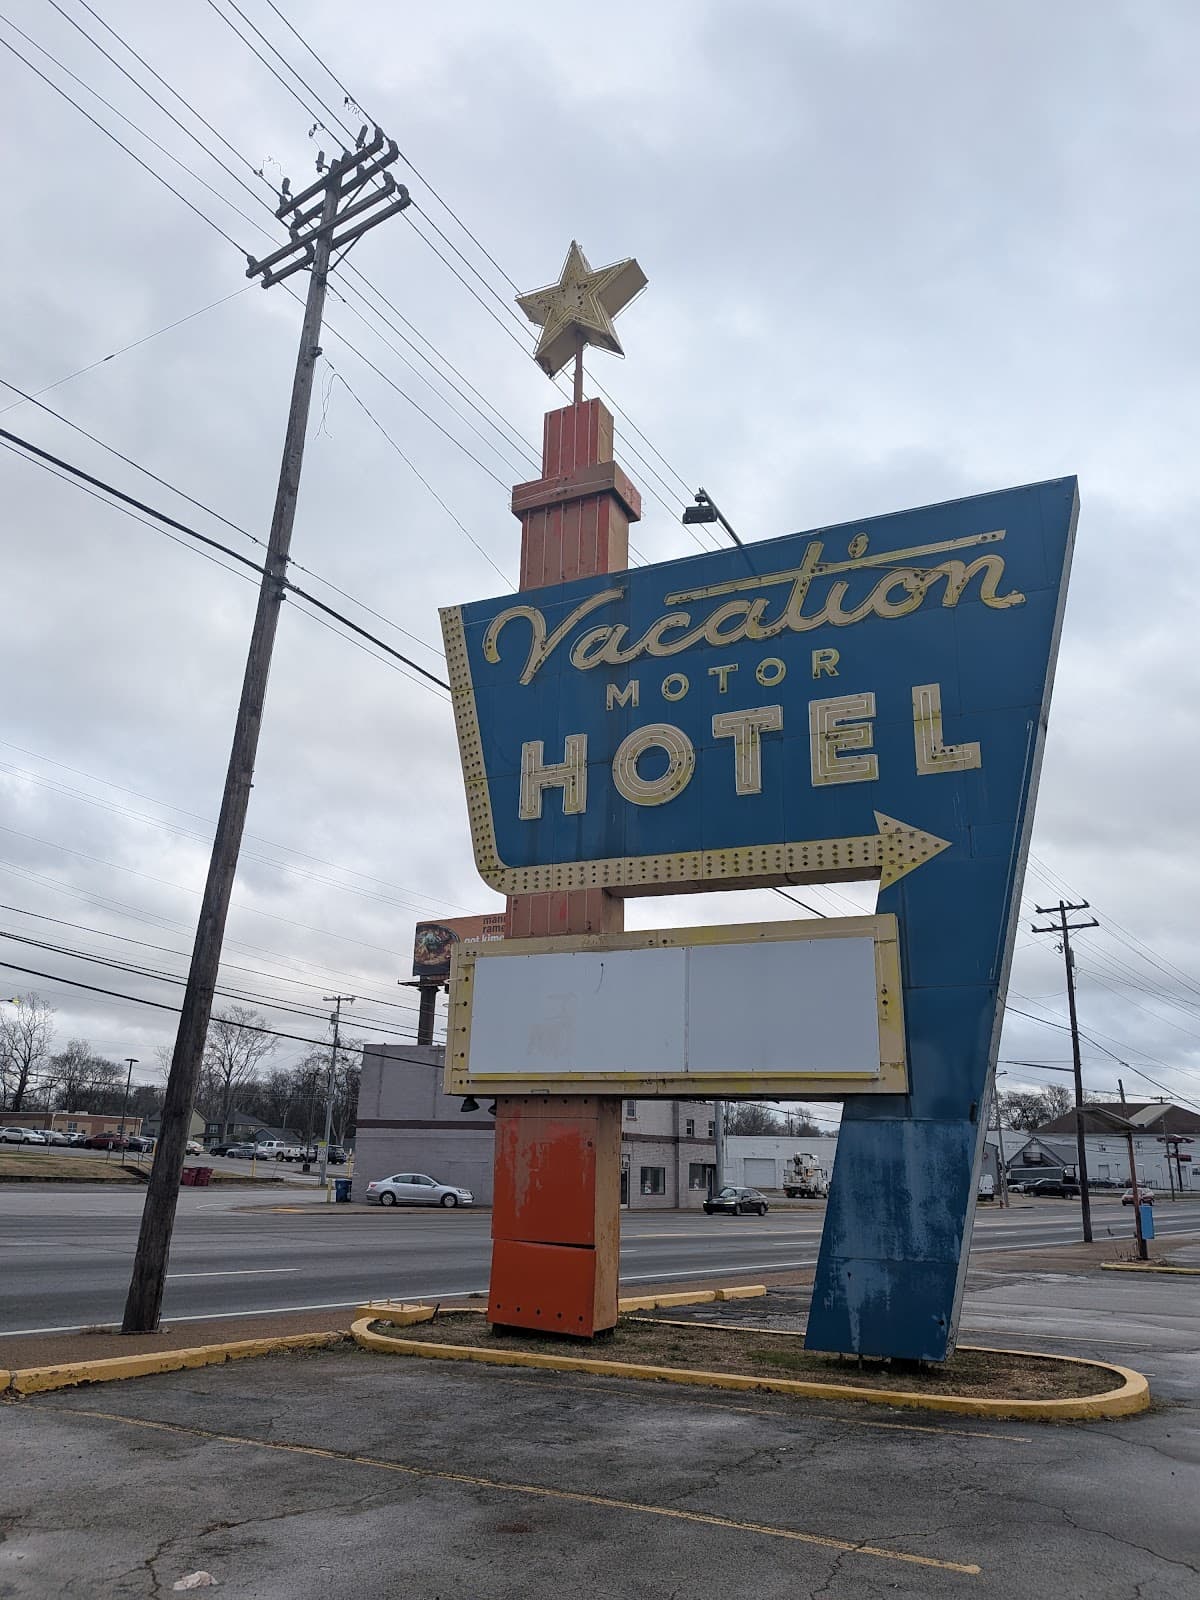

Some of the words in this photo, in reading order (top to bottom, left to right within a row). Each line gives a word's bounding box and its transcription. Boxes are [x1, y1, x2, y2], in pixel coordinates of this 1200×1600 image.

[482, 532, 1026, 686] Vacation
[606, 648, 840, 711] MOTOR
[519, 683, 982, 820] HOTEL
